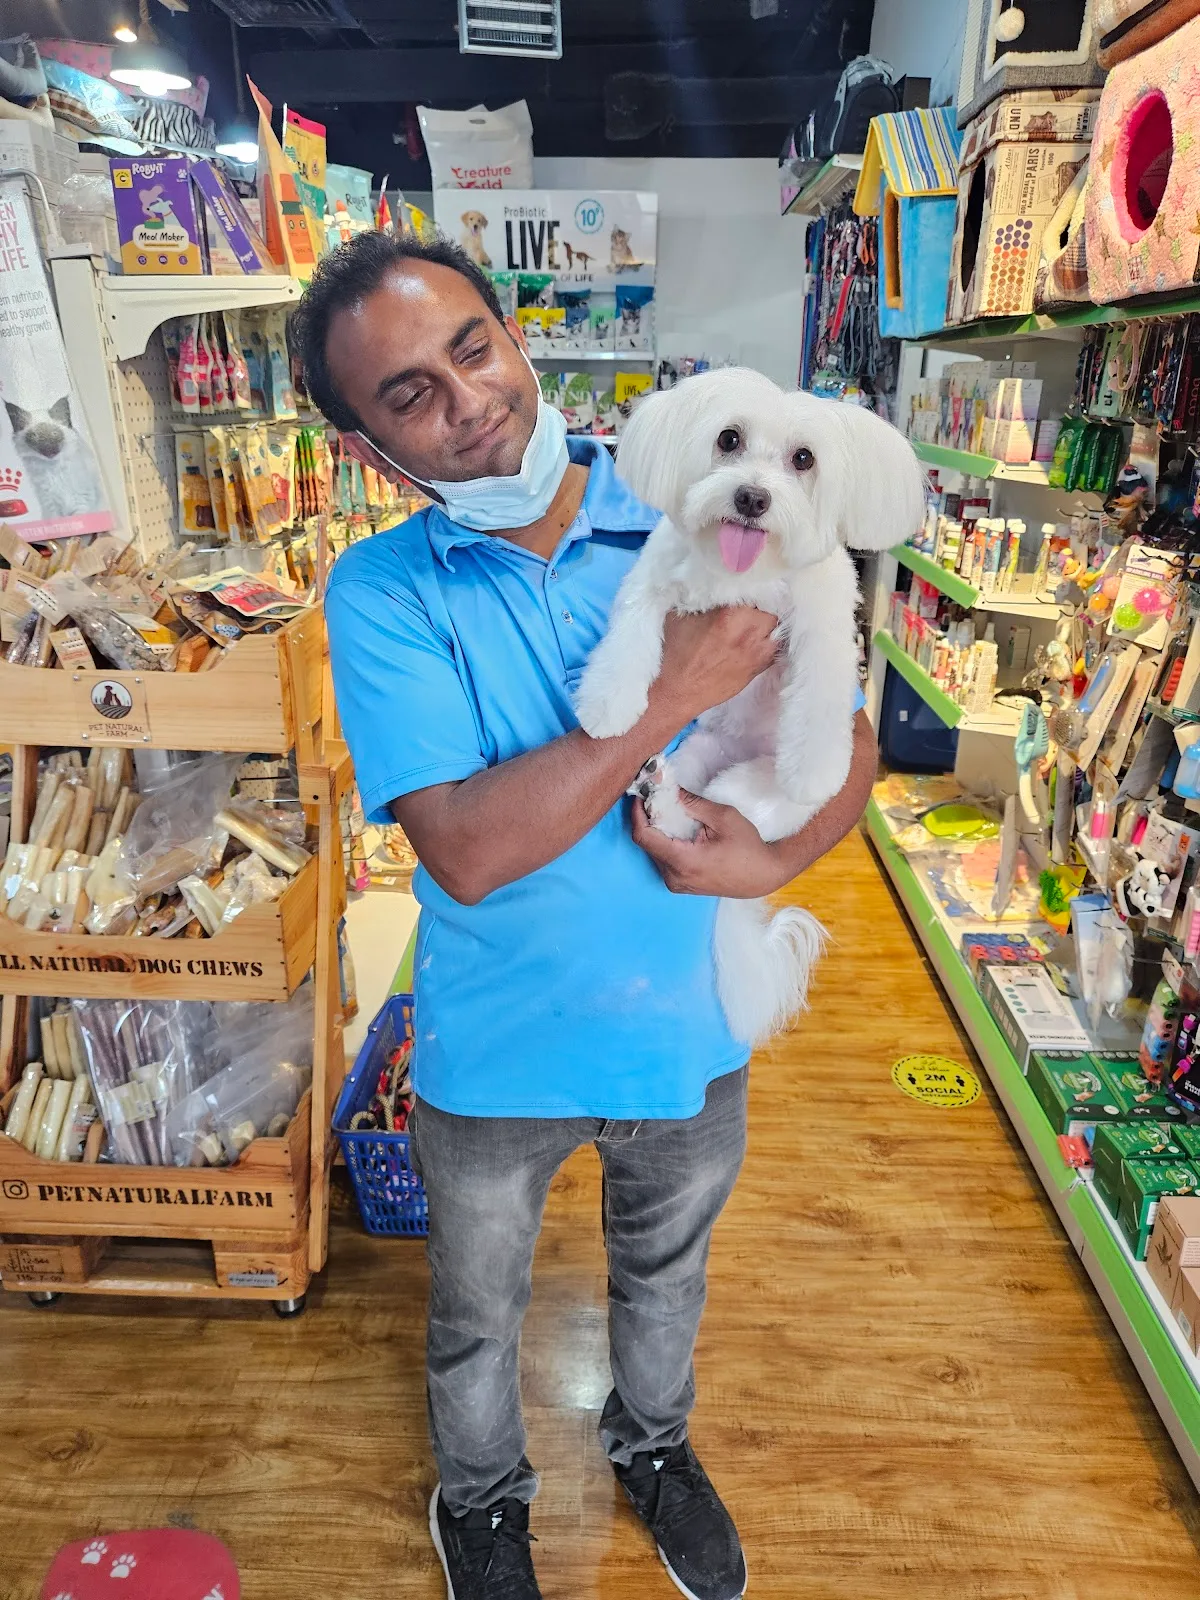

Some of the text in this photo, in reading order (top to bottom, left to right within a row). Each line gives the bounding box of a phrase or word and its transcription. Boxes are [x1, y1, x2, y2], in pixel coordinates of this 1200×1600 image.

[1025, 148, 1040, 179] PARIS
[451, 165, 512, 179] Creature
[504, 206, 547, 218] ProBiotic
[138, 232, 185, 242] Meal Maker
[505, 220, 561, 270] LIVE
[575, 274, 594, 282] LIFE
[19, 303, 48, 322] support
[25, 319, 53, 336] growth
[105, 723, 145, 733] NATURAL
[30, 955, 131, 973] NATURAL
[139, 958, 182, 974] DOG
[187, 959, 264, 977] CHEWS
[924, 1073, 947, 1082] 2M
[915, 1086, 966, 1095] SOCIAL
[37, 1184, 274, 1208] PETNATURALFARM
